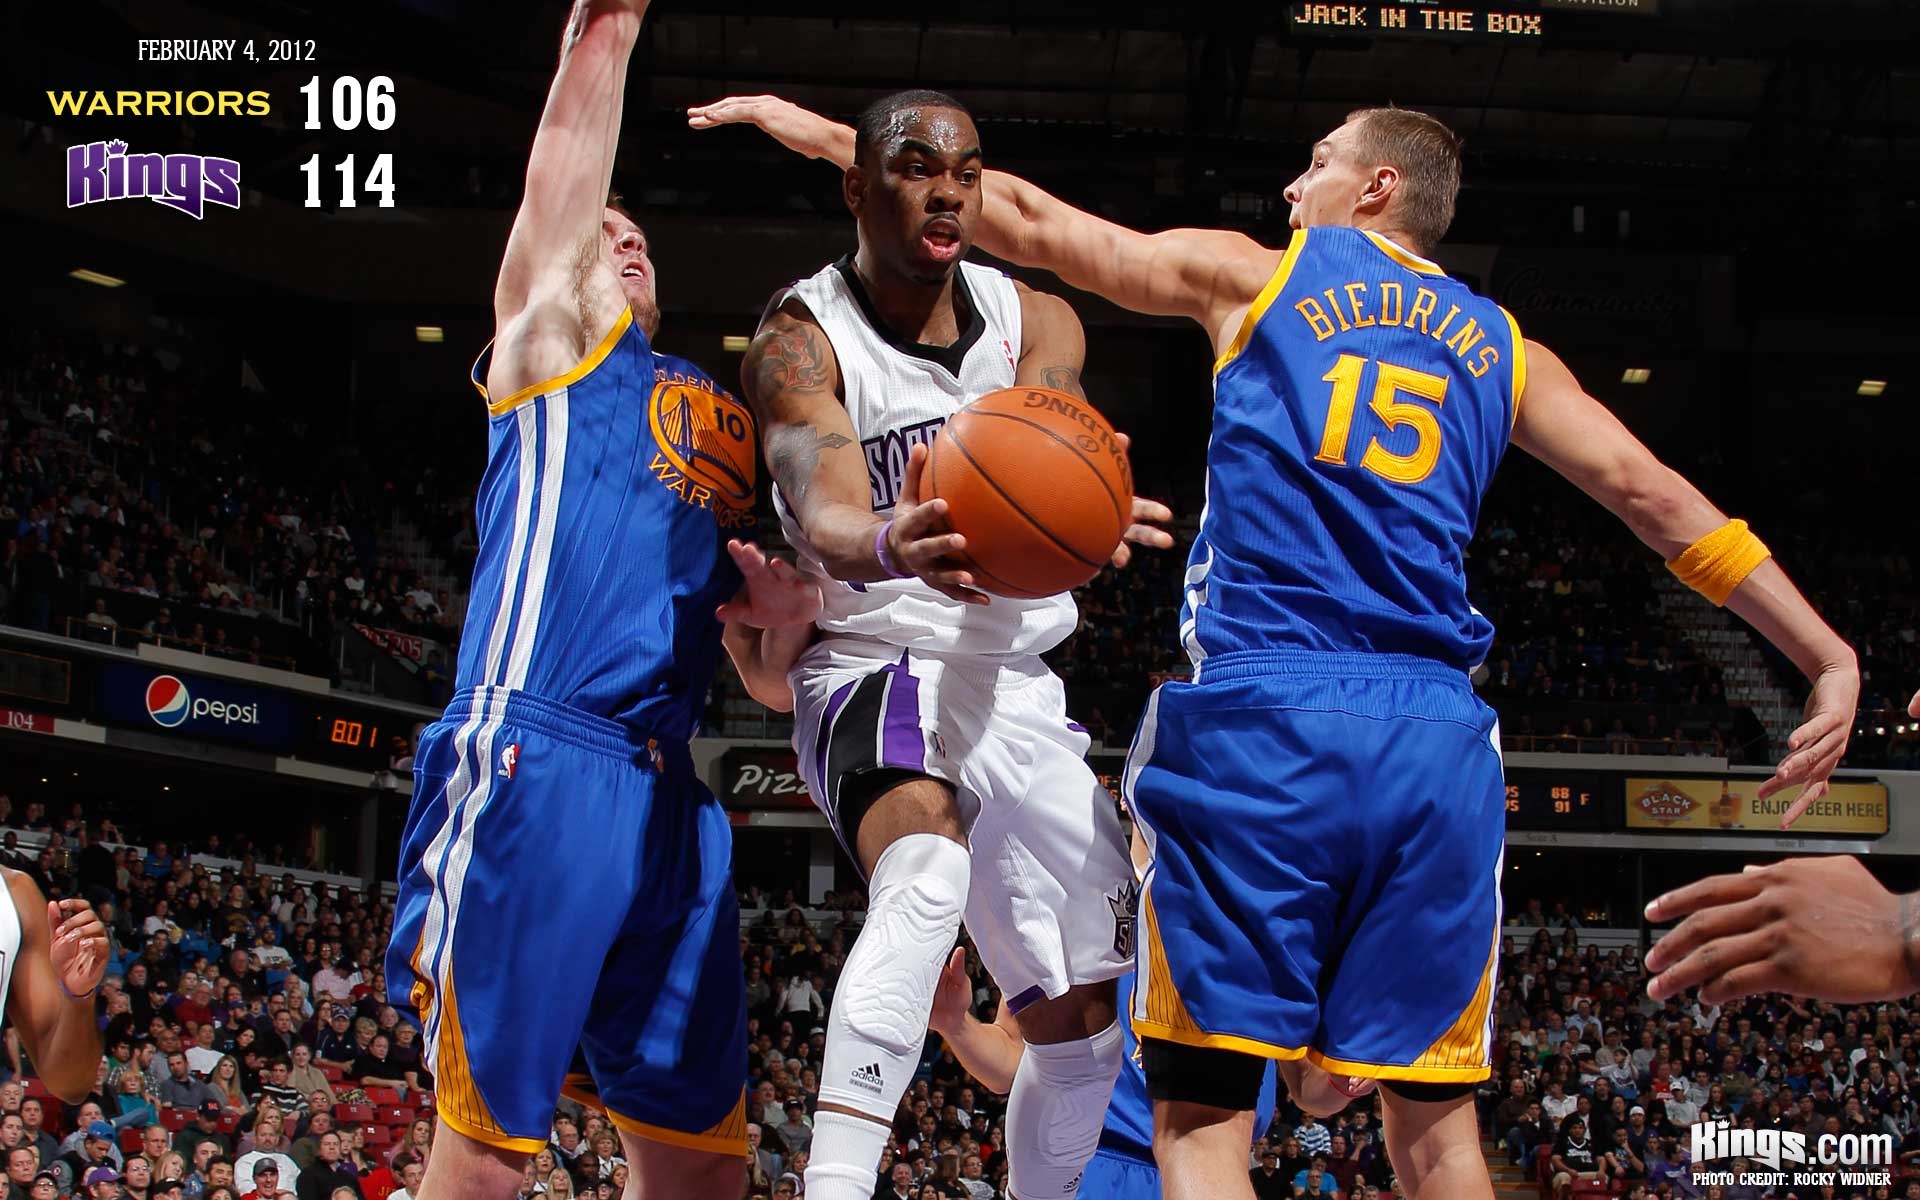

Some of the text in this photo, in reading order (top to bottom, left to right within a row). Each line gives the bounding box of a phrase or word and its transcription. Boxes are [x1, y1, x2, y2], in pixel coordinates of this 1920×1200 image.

[1295, 4, 1542, 35] JACK IN THE BOX
[1294, 282, 1500, 378] BIEDRINS
[714, 406, 746, 443] 10
[1314, 353, 1450, 484] 15
[193, 698, 258, 724] pepsi
[8, 711, 34, 730] 104
[1554, 801, 1570, 813] 91
[1580, 793, 1590, 806] F
[1641, 793, 1691, 809] BLACK
[1651, 807, 1681, 815] STAR
[1752, 800, 1793, 815] ENJO
[1846, 803, 1884, 818] HERE
[851, 1070, 884, 1087] adidas
